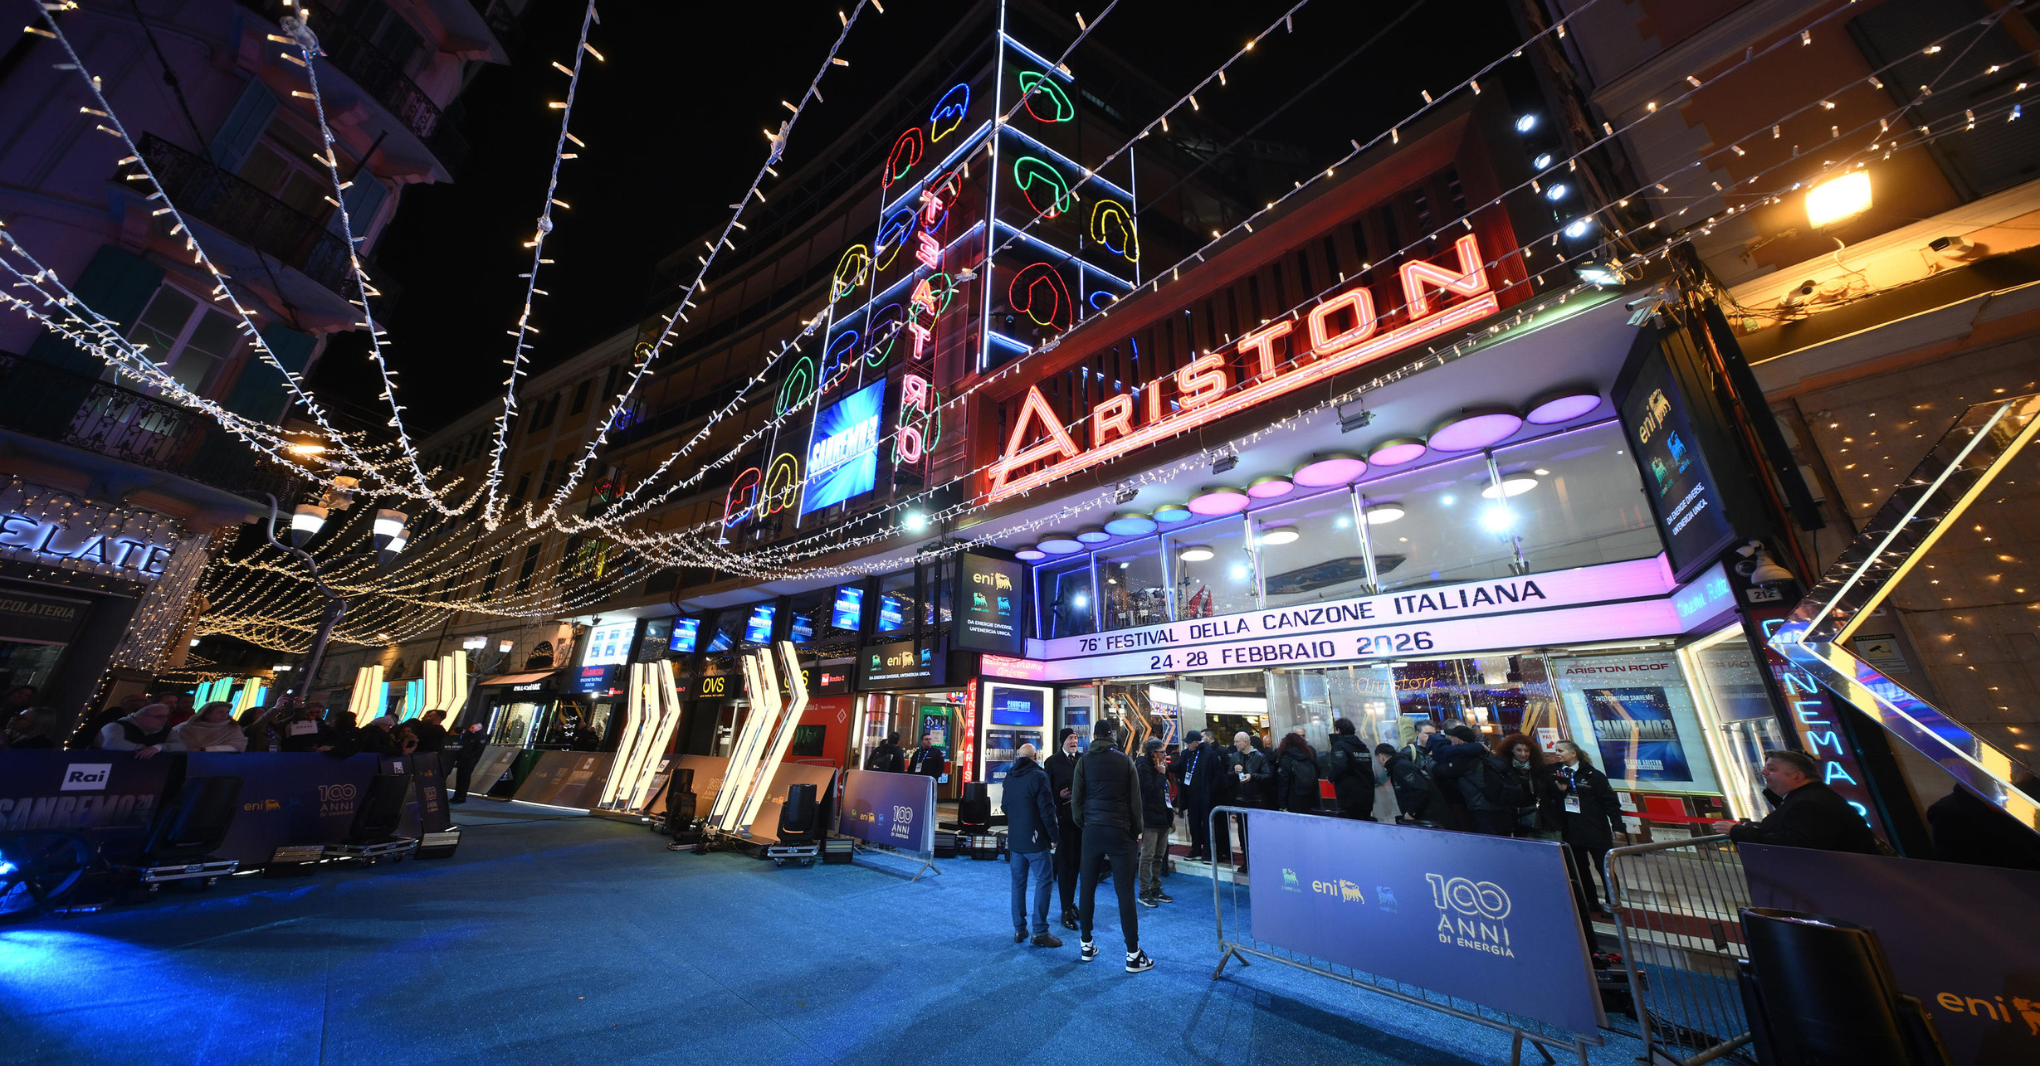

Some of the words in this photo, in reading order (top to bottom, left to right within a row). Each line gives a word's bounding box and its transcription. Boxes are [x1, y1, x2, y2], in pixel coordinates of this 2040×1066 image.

[988, 233, 1498, 502] ARISTON
[1639, 404, 1657, 444] eni
[0, 515, 175, 575] ELATE
[973, 572, 994, 586] eni
[1753, 590, 1776, 600] 212
[0, 598, 75, 619] COLATERIA
[1106, 628, 1179, 650] FESTIVAL
[1190, 618, 1251, 640] DELLA
[1262, 602, 1375, 631] CANZONE
[1394, 580, 1547, 615] ITALIANA
[1222, 640, 1336, 664] FEBBRAIO
[1356, 631, 1434, 655] 2026
[887, 652, 902, 667] eni
[1565, 665, 1627, 675] ARISTON
[1628, 663, 1669, 672] ROOF
[702, 677, 725, 694] OVS
[966, 682, 977, 736] CINEMA
[1762, 618, 1857, 786] CNEMA
[68, 770, 106, 783] Rai
[318, 783, 357, 801] 100
[244, 800, 264, 811] eni
[320, 803, 354, 812] ANNI
[893, 805, 914, 824] 100
[891, 823, 910, 834] ANNI
[1312, 879, 1338, 897] eni
[1425, 872, 1512, 920] 100
[1437, 914, 1510, 945] ANNI
[1438, 933, 1452, 944] DI
[1457, 937, 1515, 959] ENERGIA
[1936, 992, 2012, 1023] eni
